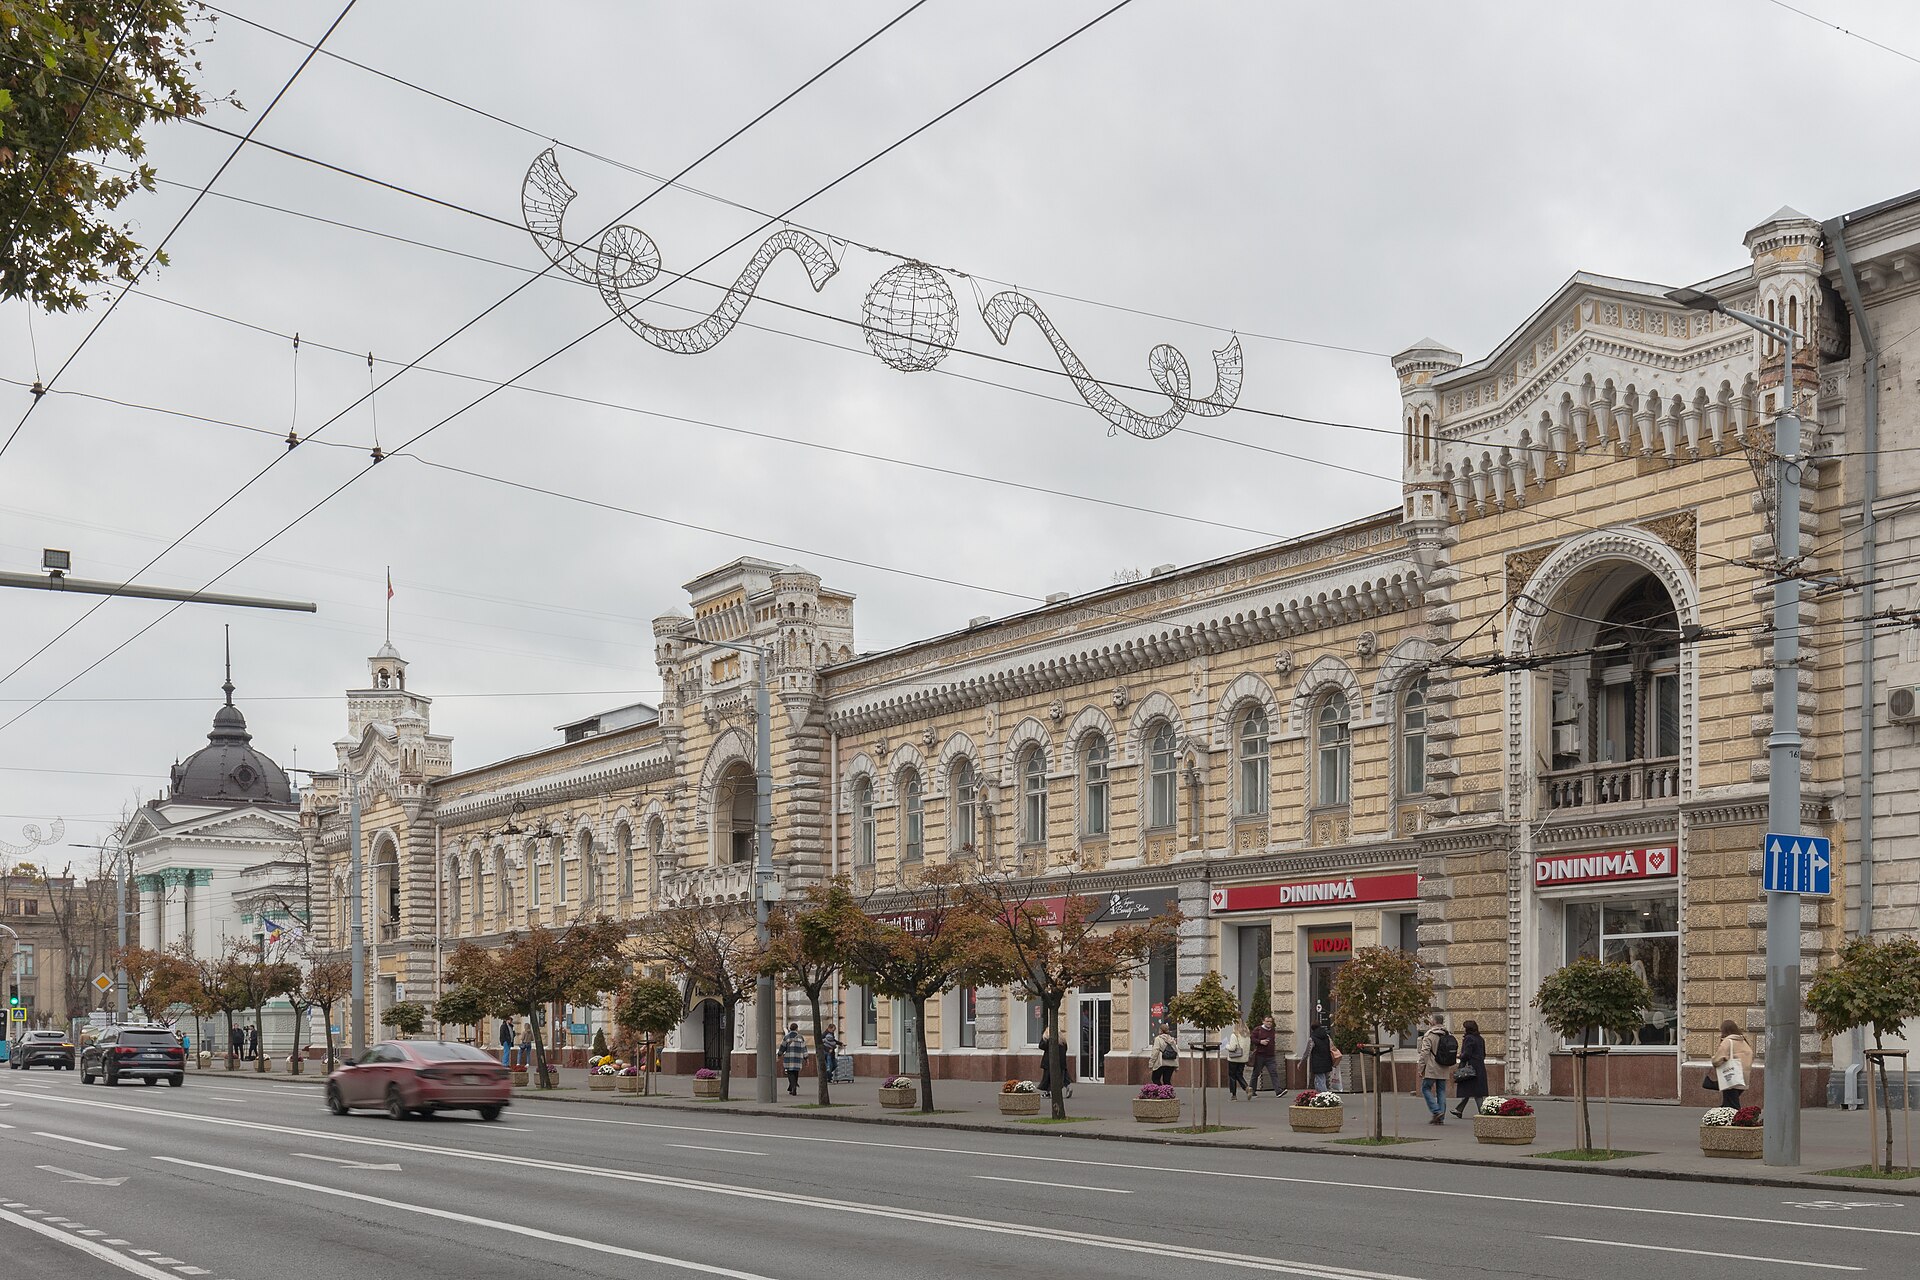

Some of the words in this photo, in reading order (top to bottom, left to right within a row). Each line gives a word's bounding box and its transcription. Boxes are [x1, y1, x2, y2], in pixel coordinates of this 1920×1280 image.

[1536, 850, 1639, 881] DININIMĂ
[1280, 876, 1357, 903] DININIMĂ
[1313, 937, 1351, 952] MODA
